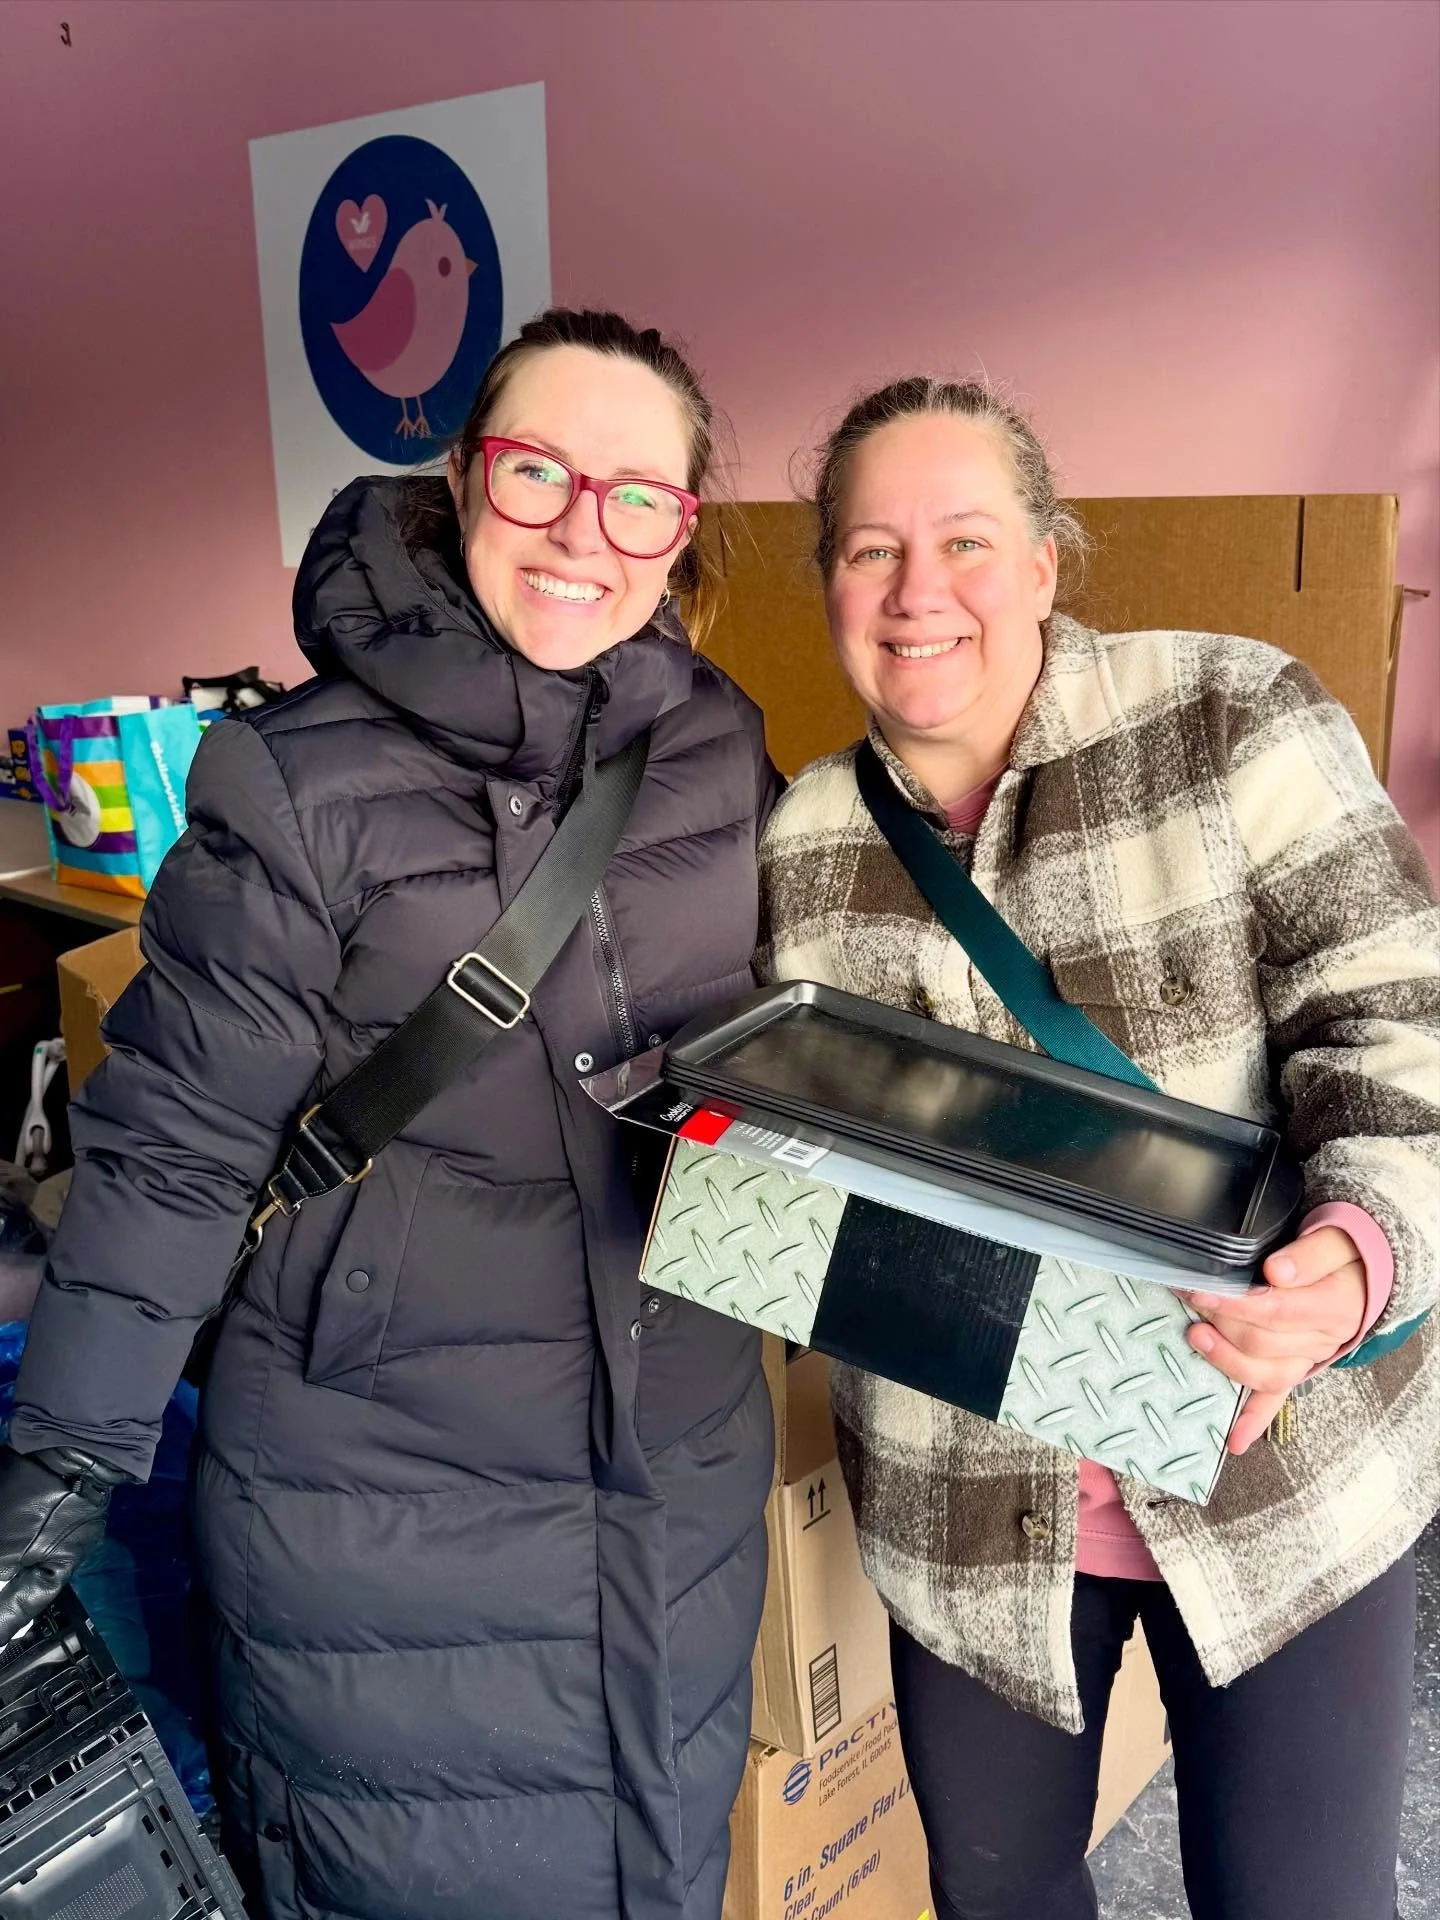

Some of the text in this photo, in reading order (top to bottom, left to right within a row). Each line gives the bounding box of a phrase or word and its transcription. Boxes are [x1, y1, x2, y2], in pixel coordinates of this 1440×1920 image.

[819, 1784, 836, 1806] Lake
[870, 1738, 892, 1764] 60045
[784, 1875, 794, 1901] 6
[797, 1865, 815, 1891] in.
[820, 1815, 868, 1870] Square
[871, 1785, 897, 1825] Flat
[784, 1886, 817, 1920] Clear
[811, 1849, 881, 1920] Count (6/60)
